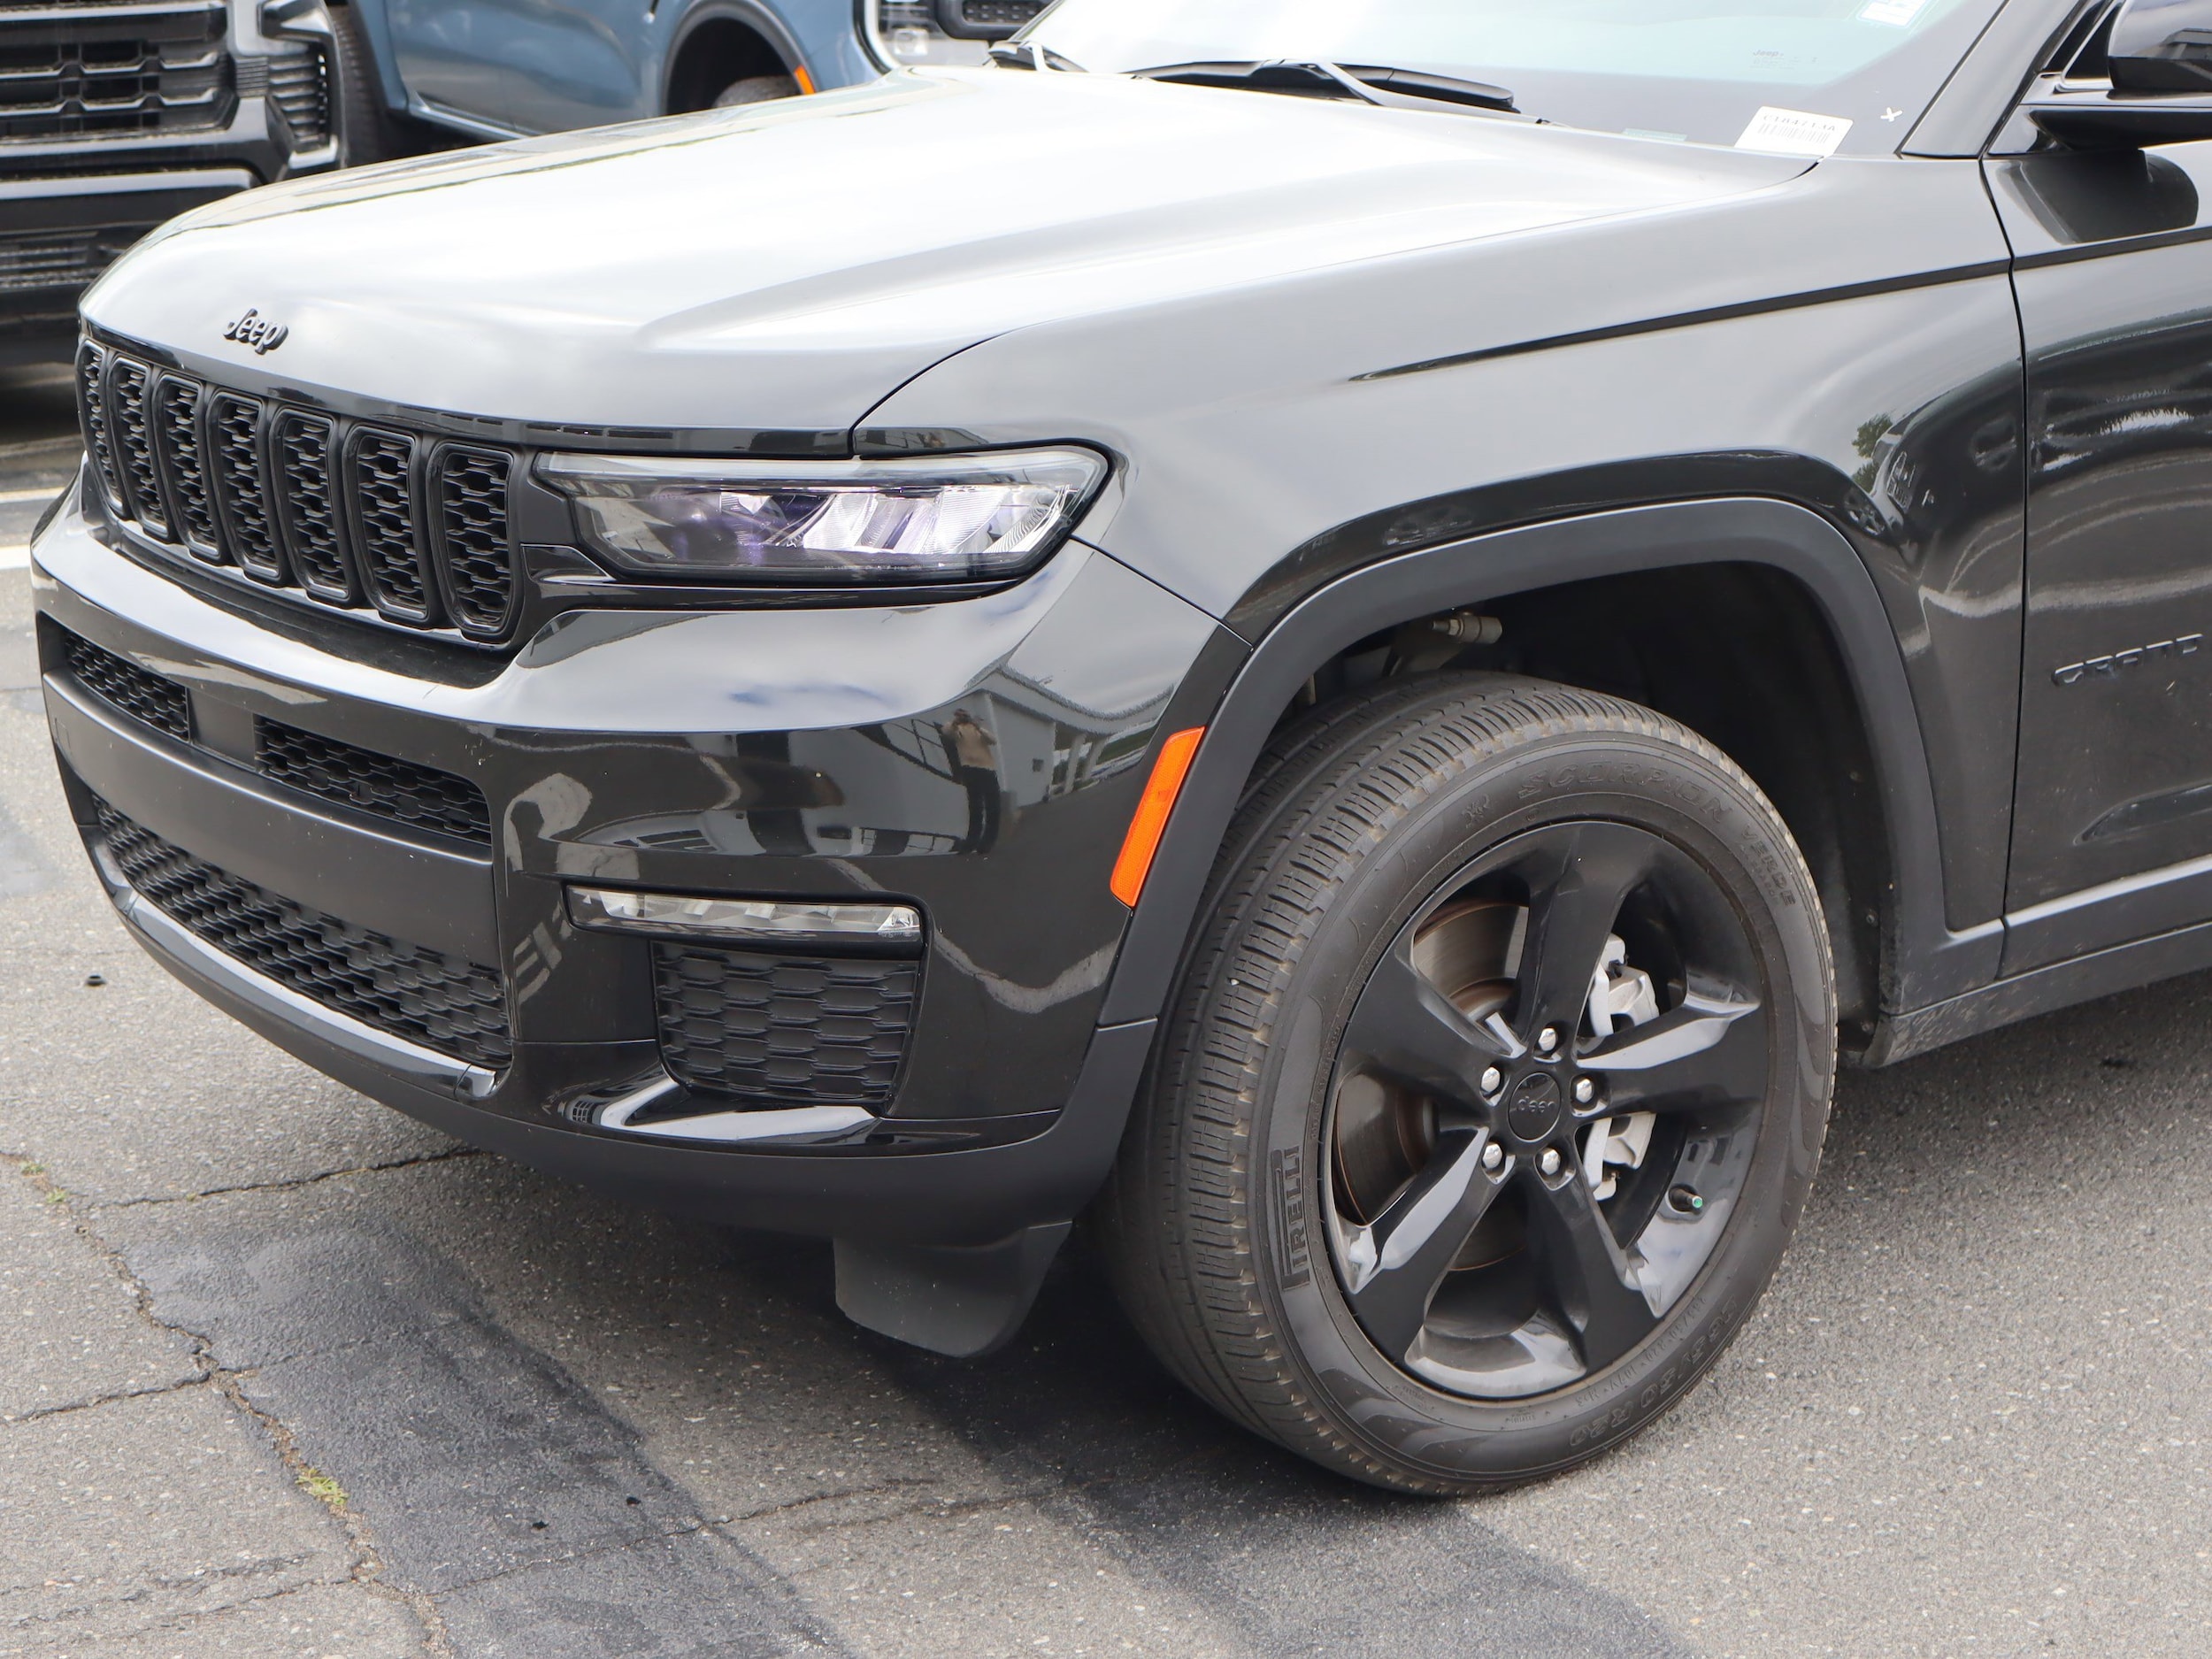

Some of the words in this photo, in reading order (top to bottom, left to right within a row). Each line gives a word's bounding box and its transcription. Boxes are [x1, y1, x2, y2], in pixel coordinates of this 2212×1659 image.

[222, 308, 289, 356] Jeep
[1517, 760, 1732, 825] SCORPION
[1740, 825, 1796, 906] VERDE
[1269, 1144, 1311, 1294] PIRELLI
